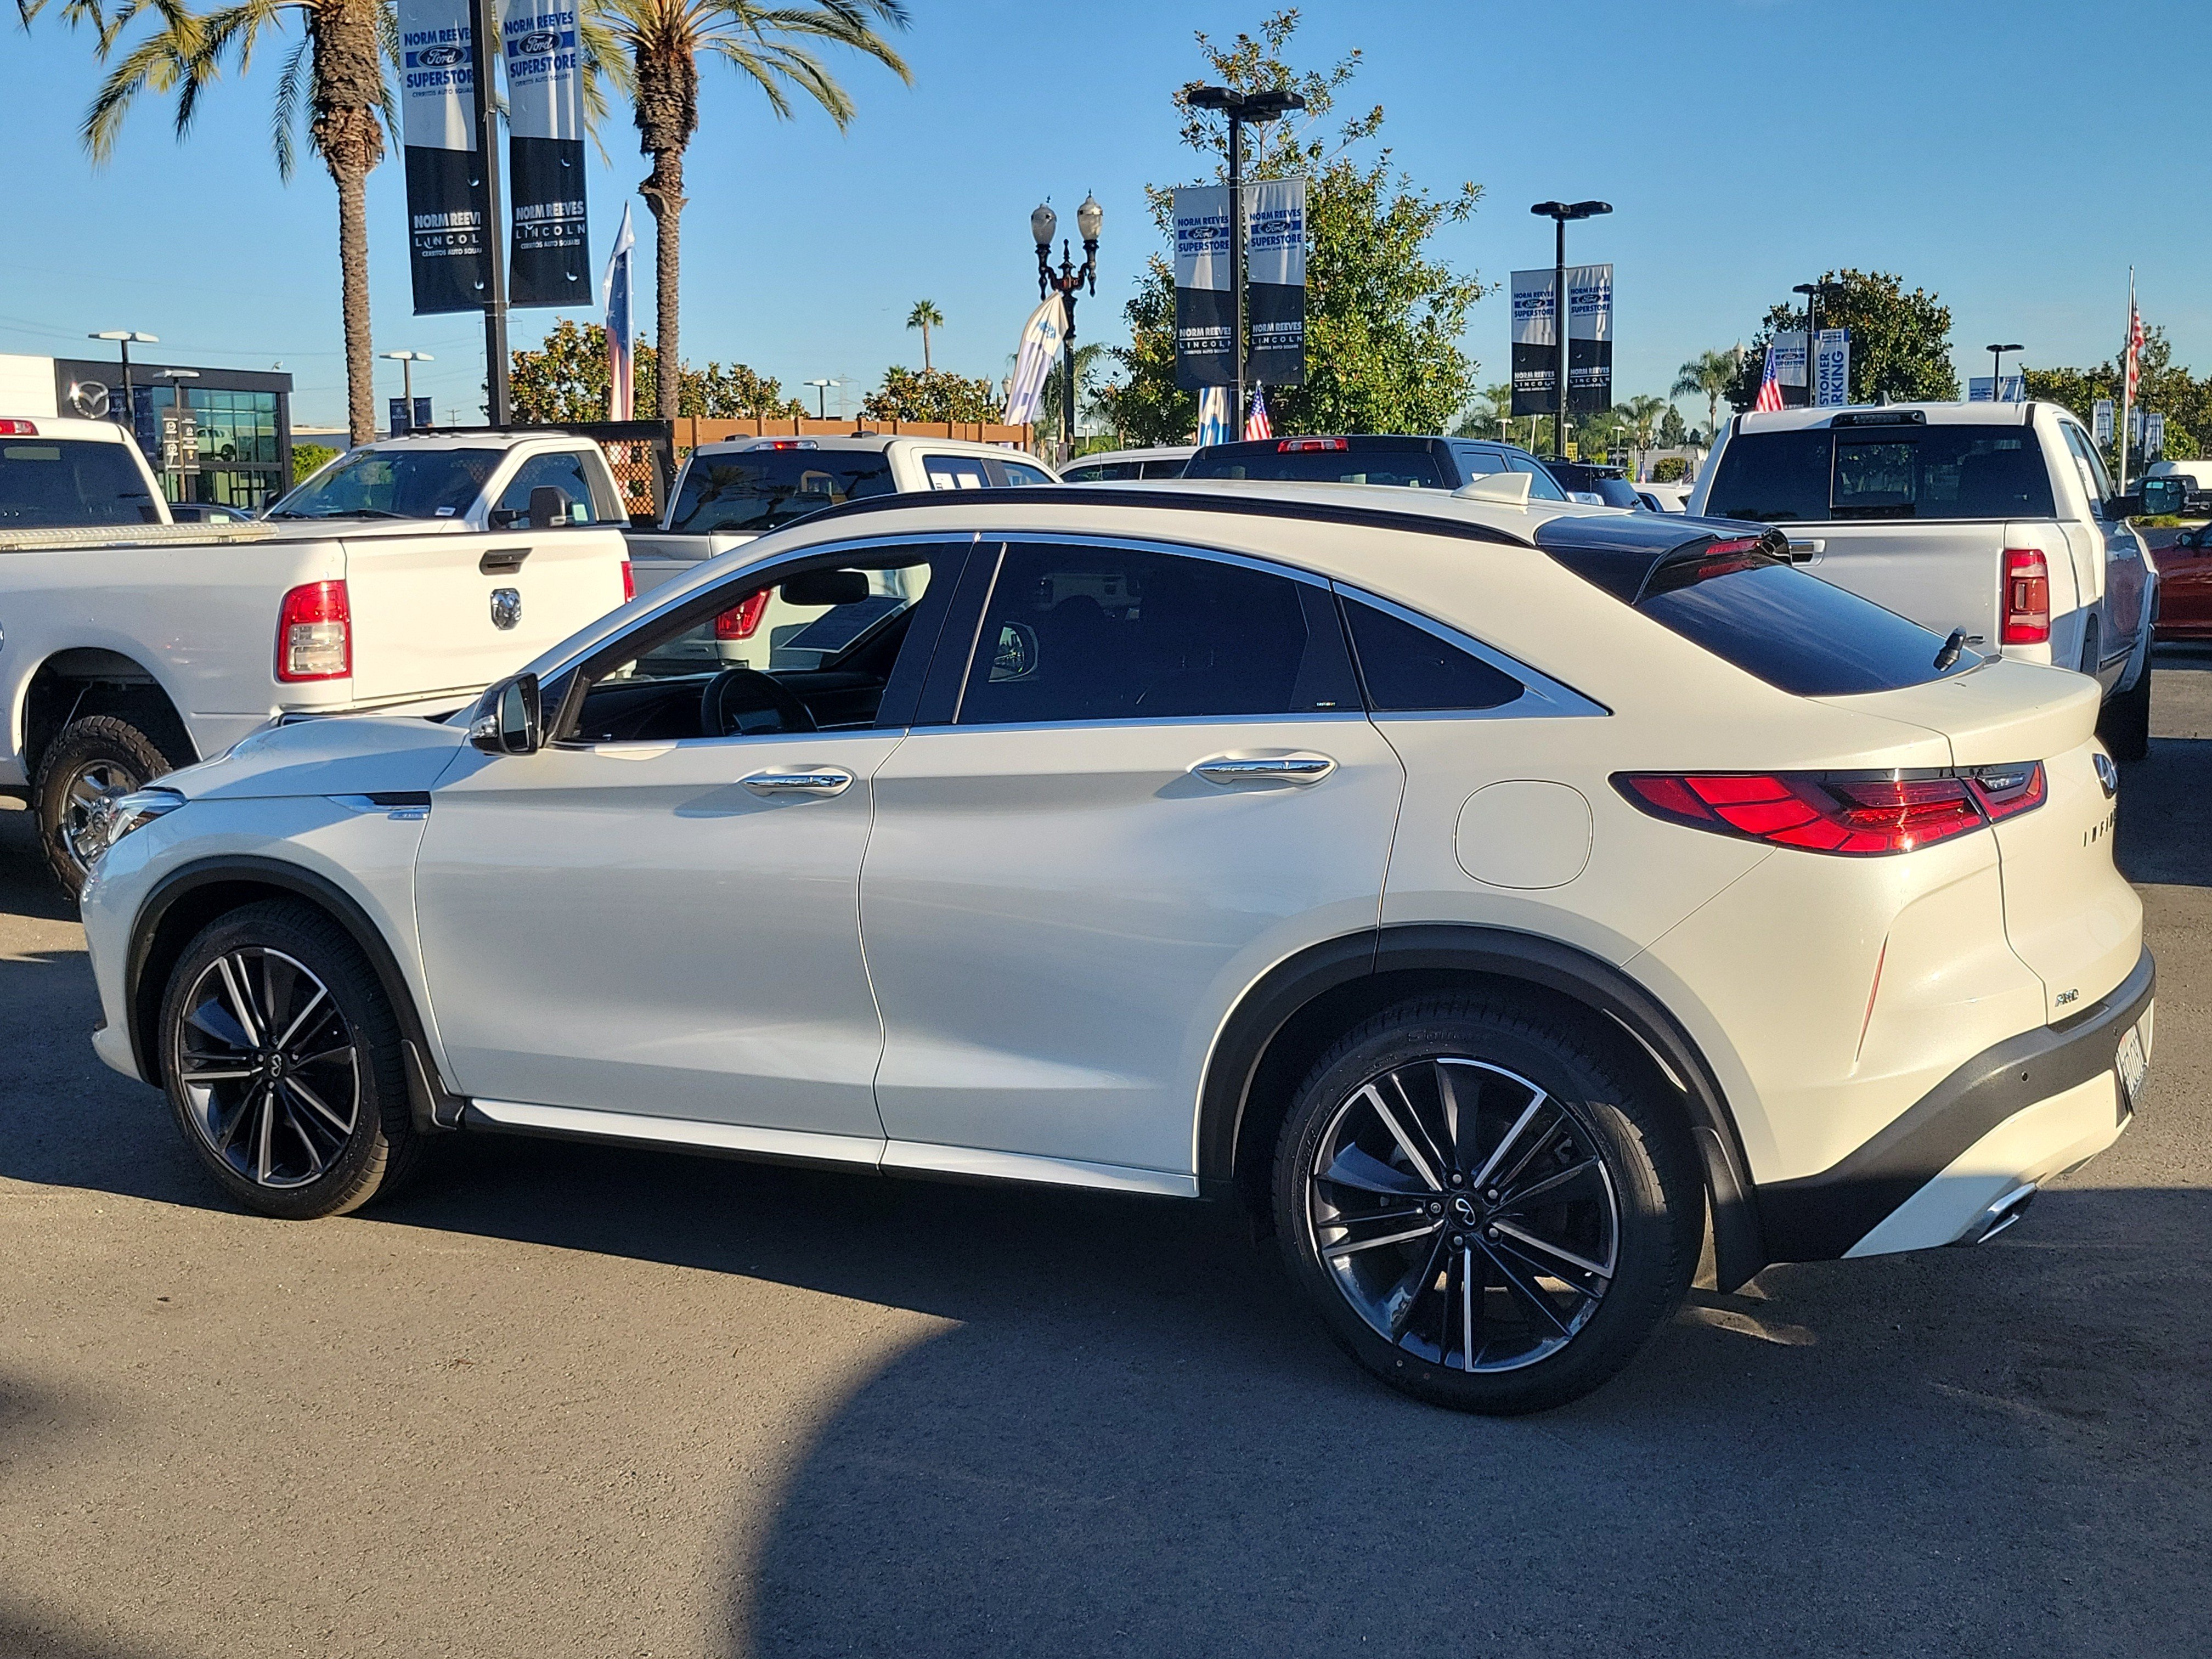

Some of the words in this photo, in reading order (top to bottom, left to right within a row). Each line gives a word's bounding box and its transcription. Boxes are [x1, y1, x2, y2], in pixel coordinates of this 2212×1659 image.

[504, 18, 534, 35] NORM
[537, 11, 574, 29] REEVES
[404, 30, 437, 46] NORM
[439, 27, 470, 43] REEVE
[526, 34, 553, 52] Ford
[427, 48, 456, 65] Ford
[510, 53, 576, 78] SUPERSTORE
[407, 69, 474, 88] SUPERSTOR
[516, 204, 545, 221] NORM
[546, 201, 585, 217] REEVES
[1249, 211, 1273, 221] NORM
[1274, 208, 1301, 219] REEVES
[414, 212, 449, 229] NORM
[450, 212, 481, 226] REEV
[1177, 217, 1201, 227] NORM
[1203, 216, 1229, 225] REEVES
[1265, 219, 1285, 232] Ford
[516, 224, 585, 239] LINCOLN
[1193, 228, 1214, 238] Ford
[415, 234, 479, 248] LINCOL
[1178, 240, 1229, 252] SUPERSTORE
[1251, 234, 1302, 247] SUPERSTORE
[1569, 287, 1588, 295] NORM
[1514, 308, 1554, 318] SUPERSTORE
[1571, 304, 1610, 313] SUPERSTORE
[1179, 328, 1204, 338] NORM
[1252, 322, 1274, 333] NORM
[1276, 321, 1302, 331] REEVES
[1251, 335, 1303, 345] LINCOLN
[1514, 371, 1533, 379] NORM
[1534, 370, 1555, 378] REEVES
[1570, 367, 1588, 375] NORM
[1588, 366, 1610, 374] REEVES
[1820, 353, 1830, 407] STOMER
